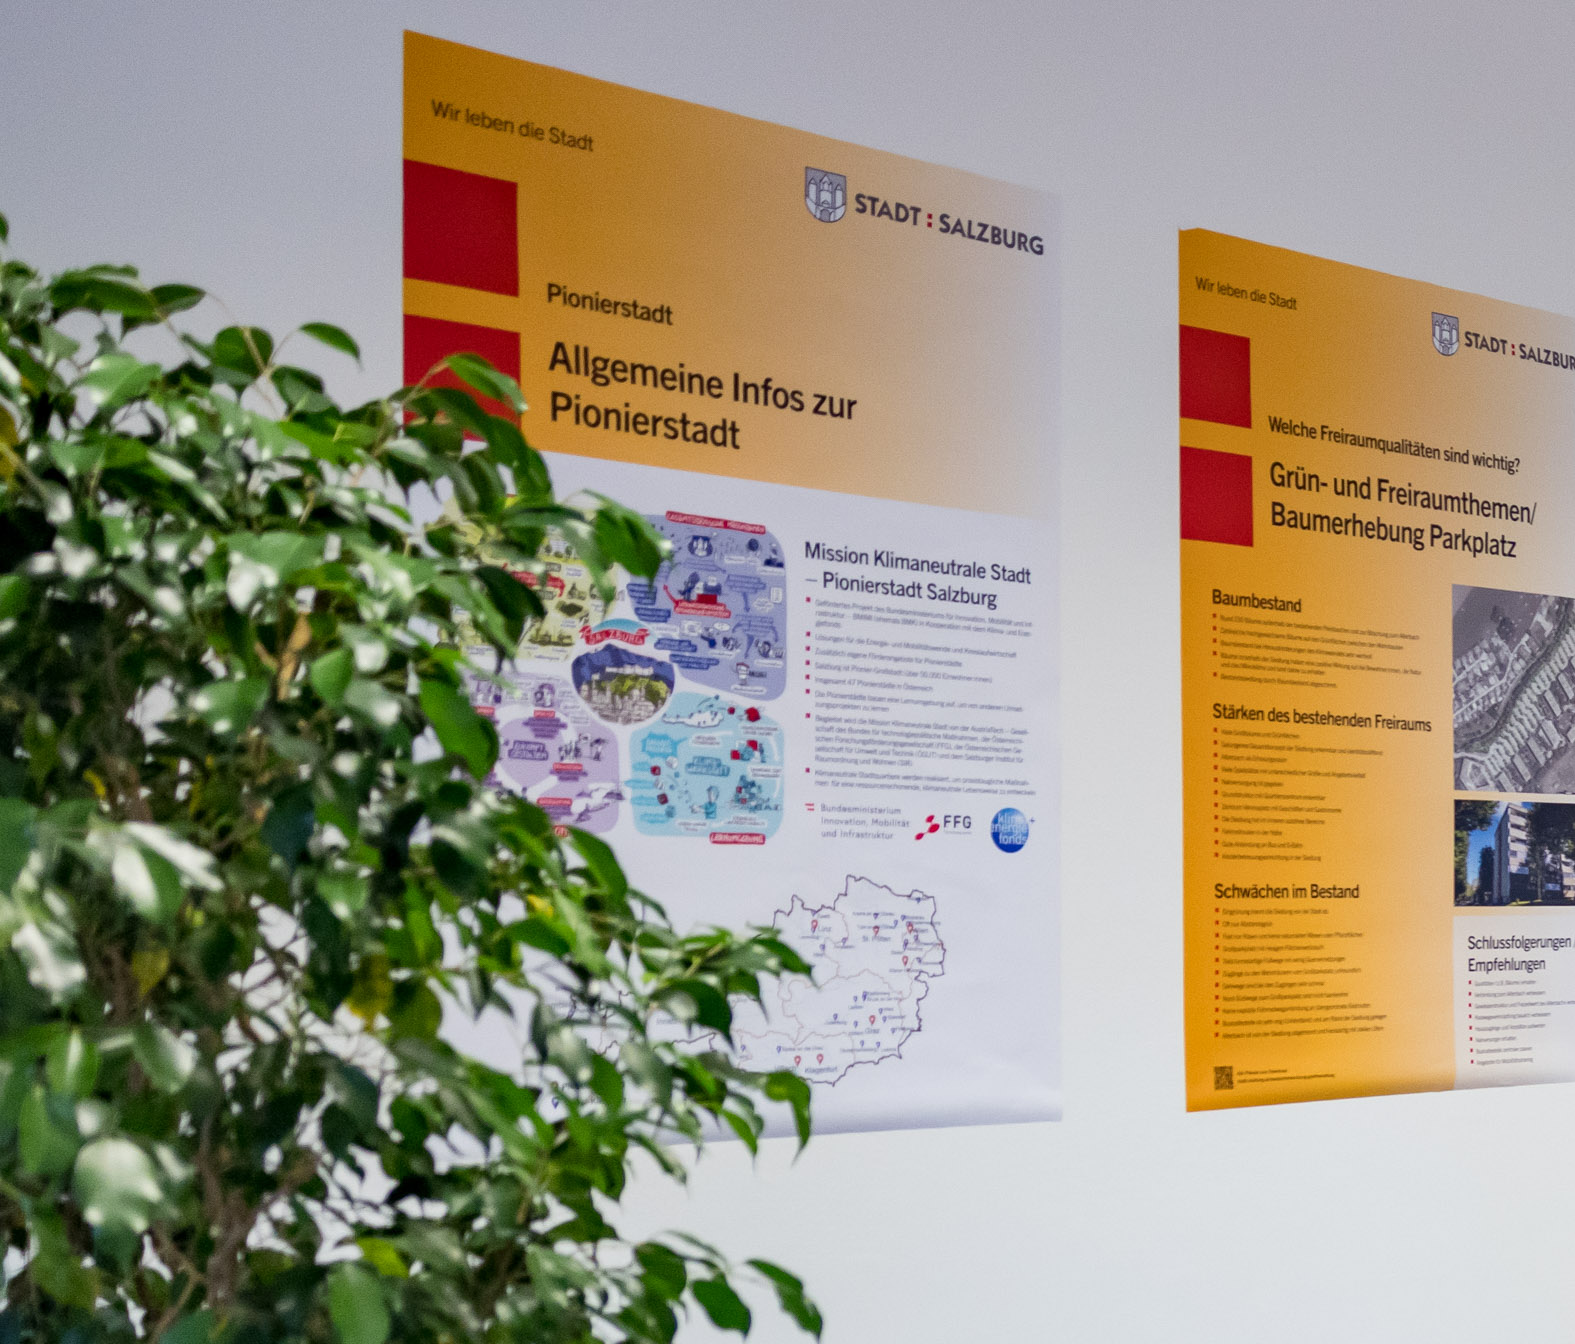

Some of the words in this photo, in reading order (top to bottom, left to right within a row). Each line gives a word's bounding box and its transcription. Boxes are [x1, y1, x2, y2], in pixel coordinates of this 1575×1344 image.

[431, 100, 461, 122] Wir
[465, 108, 514, 135] leben
[518, 119, 545, 141] die
[548, 126, 594, 153] Stadt
[855, 193, 921, 226] STADT
[938, 213, 1045, 256] SALZBURG
[546, 283, 674, 326] Pionierstadt
[548, 342, 723, 399] Allgemeine
[732, 372, 805, 413] Infos
[812, 393, 857, 420] zur
[550, 390, 741, 450] Pionierstadt
[1269, 415, 1317, 440] Welche
[1321, 425, 1440, 461] Freiraumqualitäten
[1444, 446, 1469, 465] sind
[1472, 451, 1521, 475] wichtig?
[1270, 462, 1328, 490] Grün-
[1334, 476, 1371, 501] und
[1377, 479, 1537, 526] Freiraumthemen/
[1271, 502, 1425, 552] Baumerhebung
[1430, 523, 1517, 558] Parkplatz
[805, 542, 869, 565] Mission
[874, 549, 986, 580] Klimaneutrale
[991, 564, 1031, 584] Stadt
[823, 571, 922, 600] Pionierstadt
[927, 583, 998, 611] Salzburg
[1212, 589, 1302, 613] Baumbestand
[1213, 703, 1264, 722] Stärken
[1268, 707, 1290, 724] des
[1294, 708, 1372, 728] bestehenden
[1375, 715, 1432, 732] Freiraums
[820, 804, 901, 815] Bundesministerium
[821, 817, 868, 827] Innovation,
[871, 818, 910, 828] Mobilität
[944, 816, 972, 828] FFG
[821, 828, 837, 838] und
[840, 829, 894, 840] Infrastruktur
[1215, 883, 1288, 899] Schwächen
[1292, 885, 1307, 898] im
[1311, 884, 1359, 899] Bestand
[1468, 935, 1572, 953] Schlussfolgerungen
[1468, 957, 1546, 975] Empfehlungen
